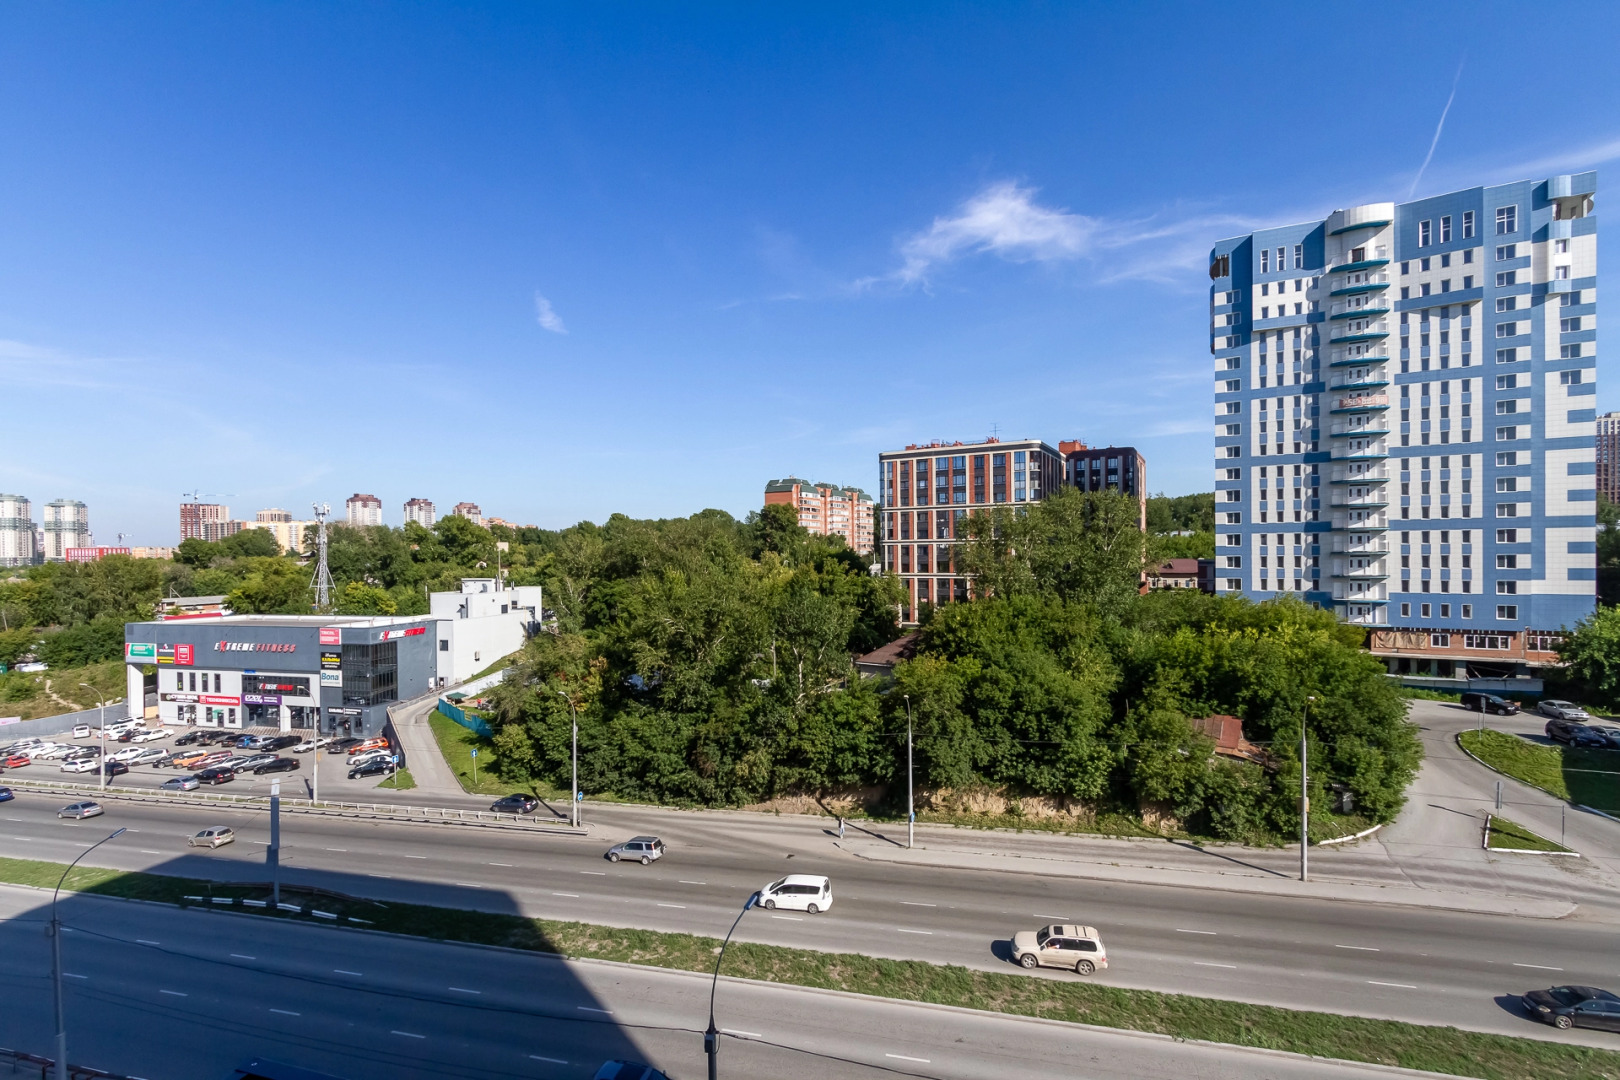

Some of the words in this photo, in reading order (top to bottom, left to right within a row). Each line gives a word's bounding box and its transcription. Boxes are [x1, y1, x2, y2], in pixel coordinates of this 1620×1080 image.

[214, 640, 255, 652] EXTREME
[255, 643, 296, 653] FITNESS
[321, 672, 339, 681] Bona
